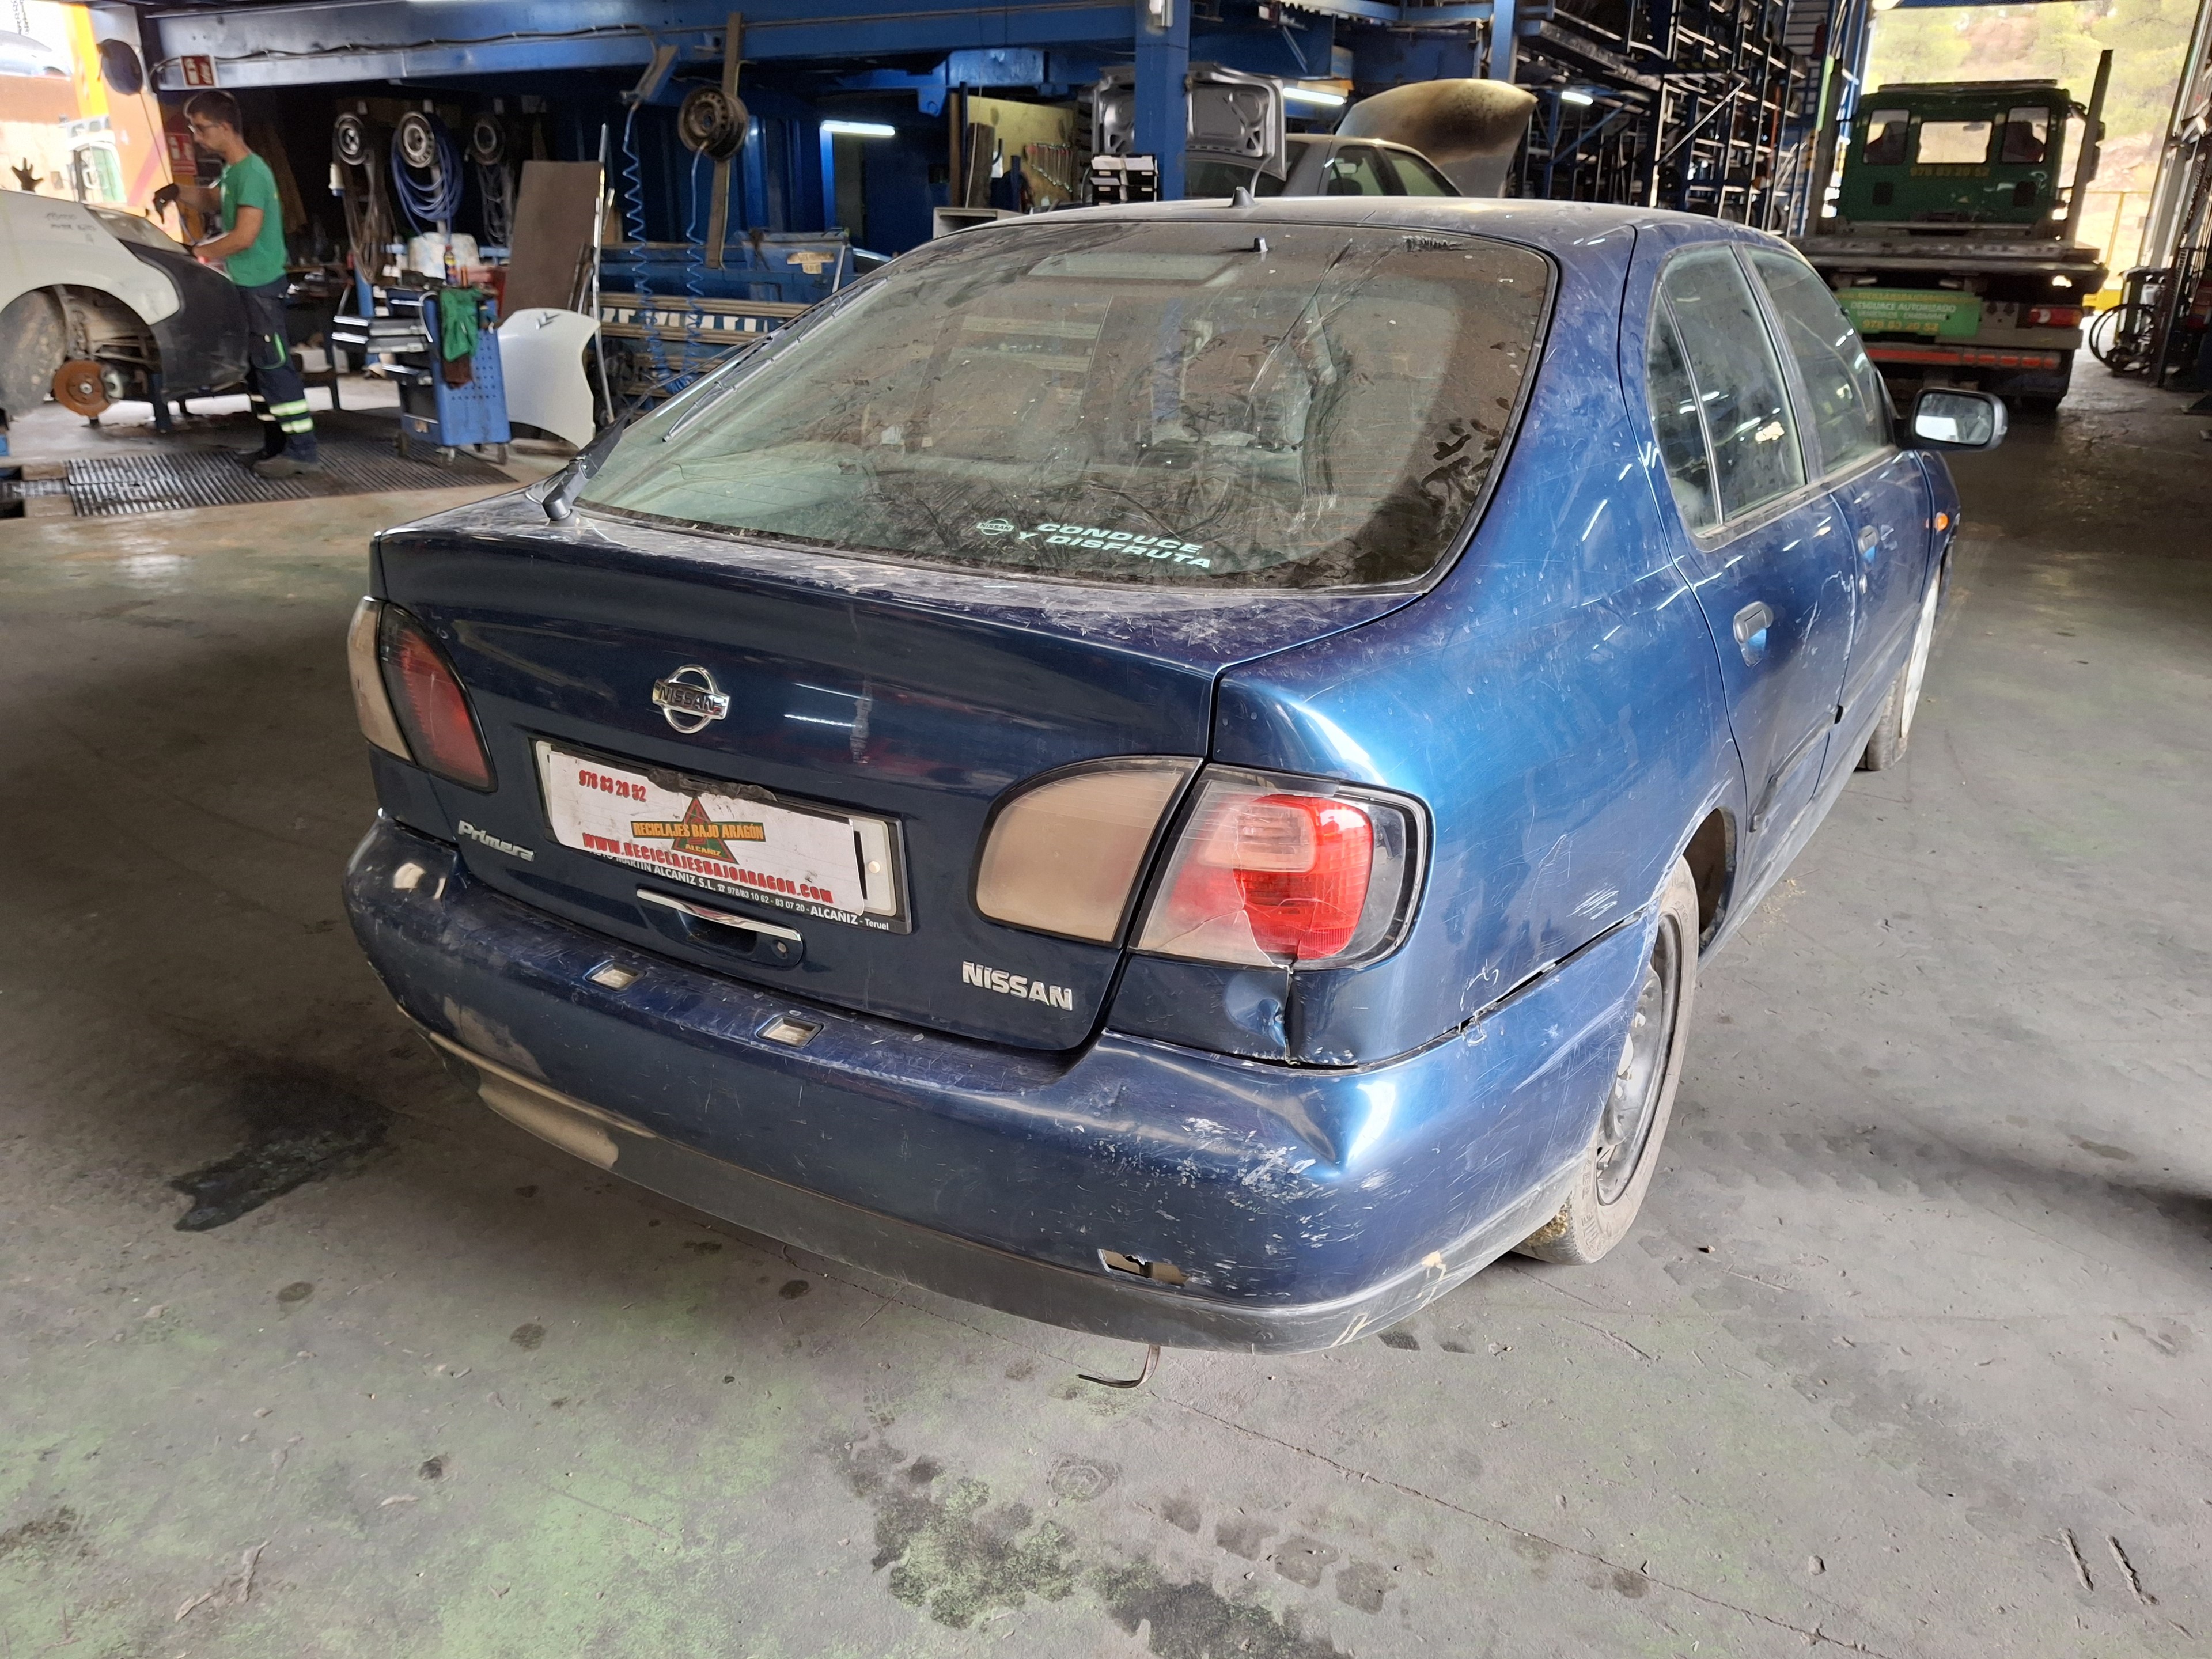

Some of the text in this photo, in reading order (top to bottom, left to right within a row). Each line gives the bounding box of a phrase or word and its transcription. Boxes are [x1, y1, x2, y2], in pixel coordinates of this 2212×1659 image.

[1018, 532, 1211, 568] Y DISFRUTA
[1037, 523, 1203, 554] CONDUCE
[659, 685, 715, 712] NISSAN
[616, 780, 630, 798] 20
[632, 784, 647, 802] 52
[458, 820, 535, 862] Primera
[633, 822, 764, 840] RECICLAJES BAJO ARAGÓN
[582, 832, 834, 904] WWW.RECICLAJESBAJOARAGON.COM
[699, 877, 716, 891] S.L.
[727, 887, 749, 899] 978/83
[751, 892, 759, 902] 10
[760, 895, 769, 904] 62
[775, 898, 784, 907] 83
[786, 900, 794, 910] 07
[796, 903, 805, 912] 20
[810, 906, 858, 925] ALCAÑIZ
[864, 918, 889, 930] Teruel
[962, 960, 1073, 1012] NISSAN
